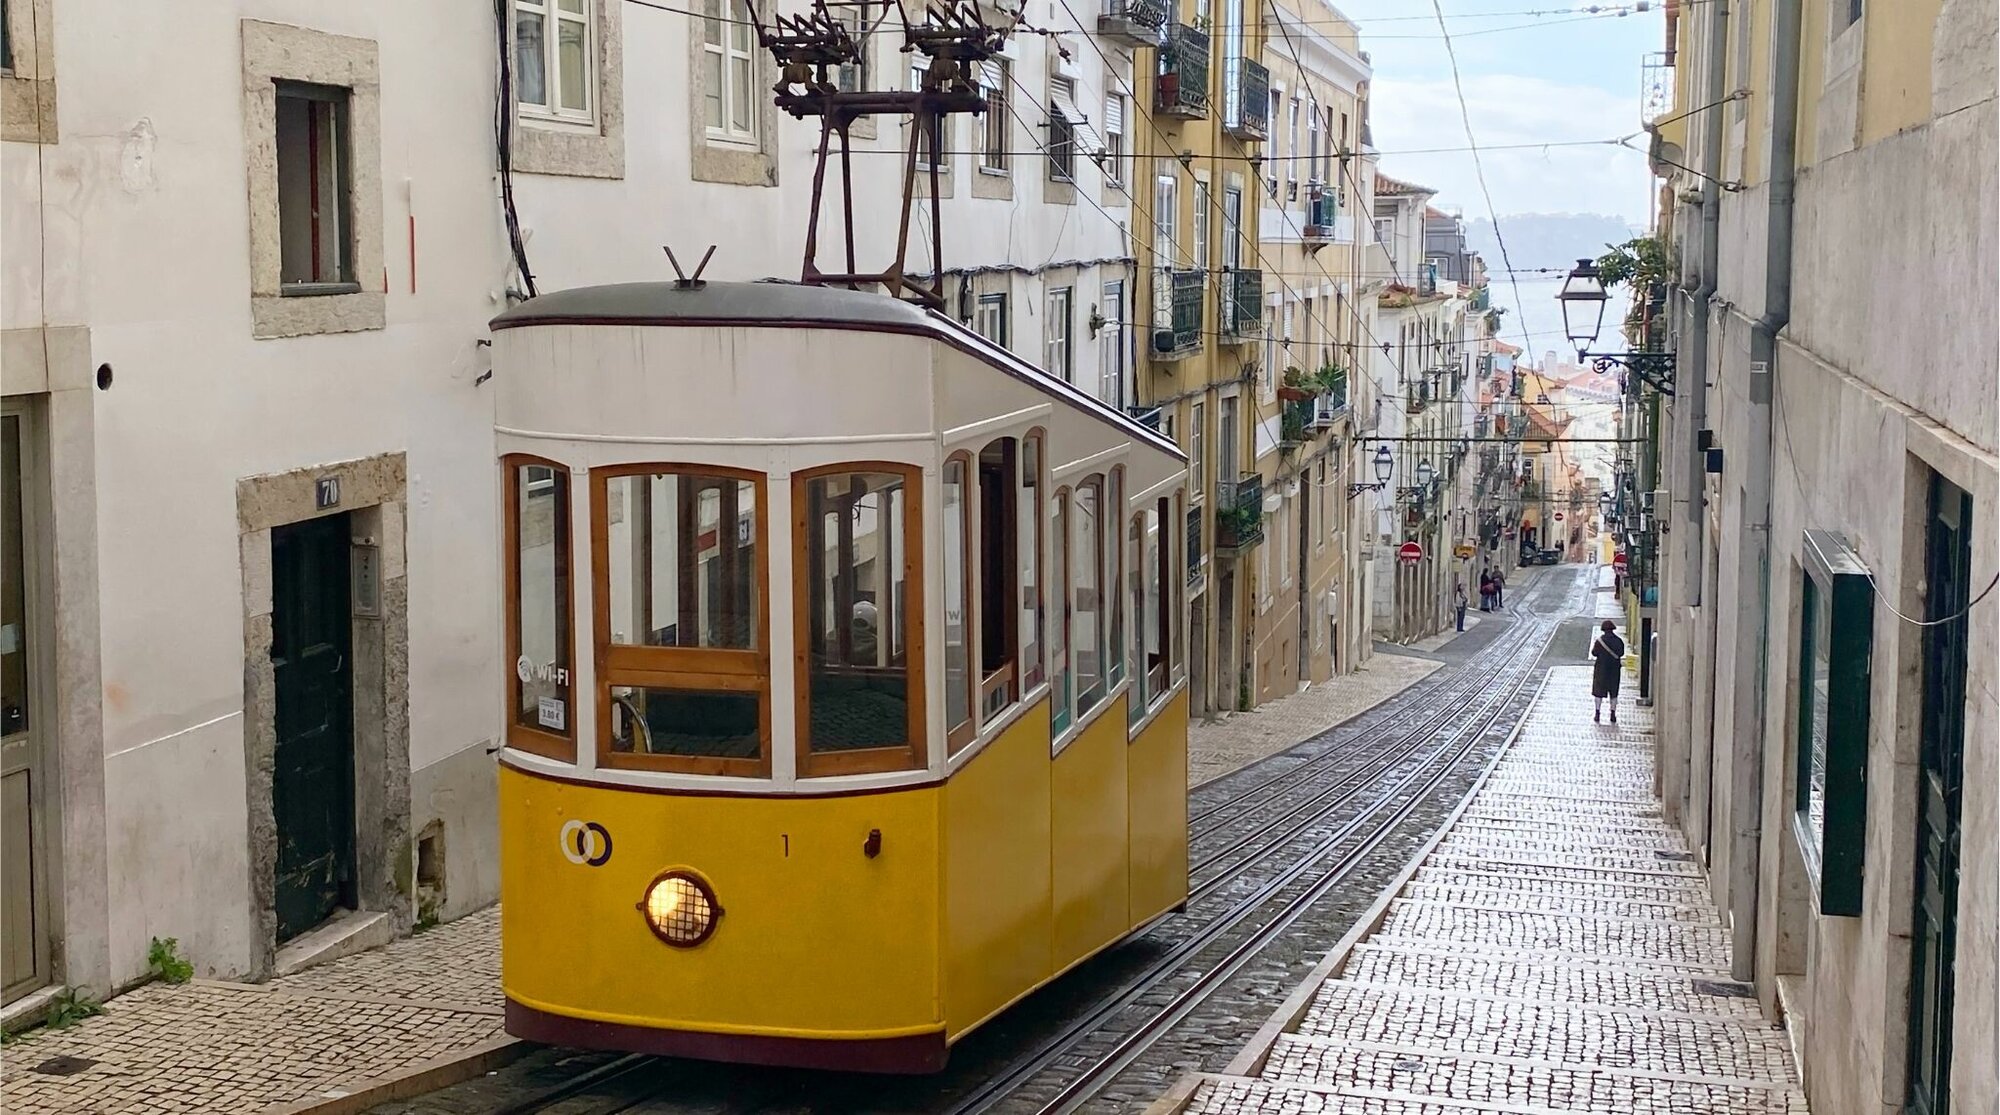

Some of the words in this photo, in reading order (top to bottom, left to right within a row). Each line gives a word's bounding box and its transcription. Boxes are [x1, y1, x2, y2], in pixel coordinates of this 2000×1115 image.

[322, 480, 337, 505] 70
[537, 664, 569, 686] WI-FI
[781, 834, 788, 858] 1
